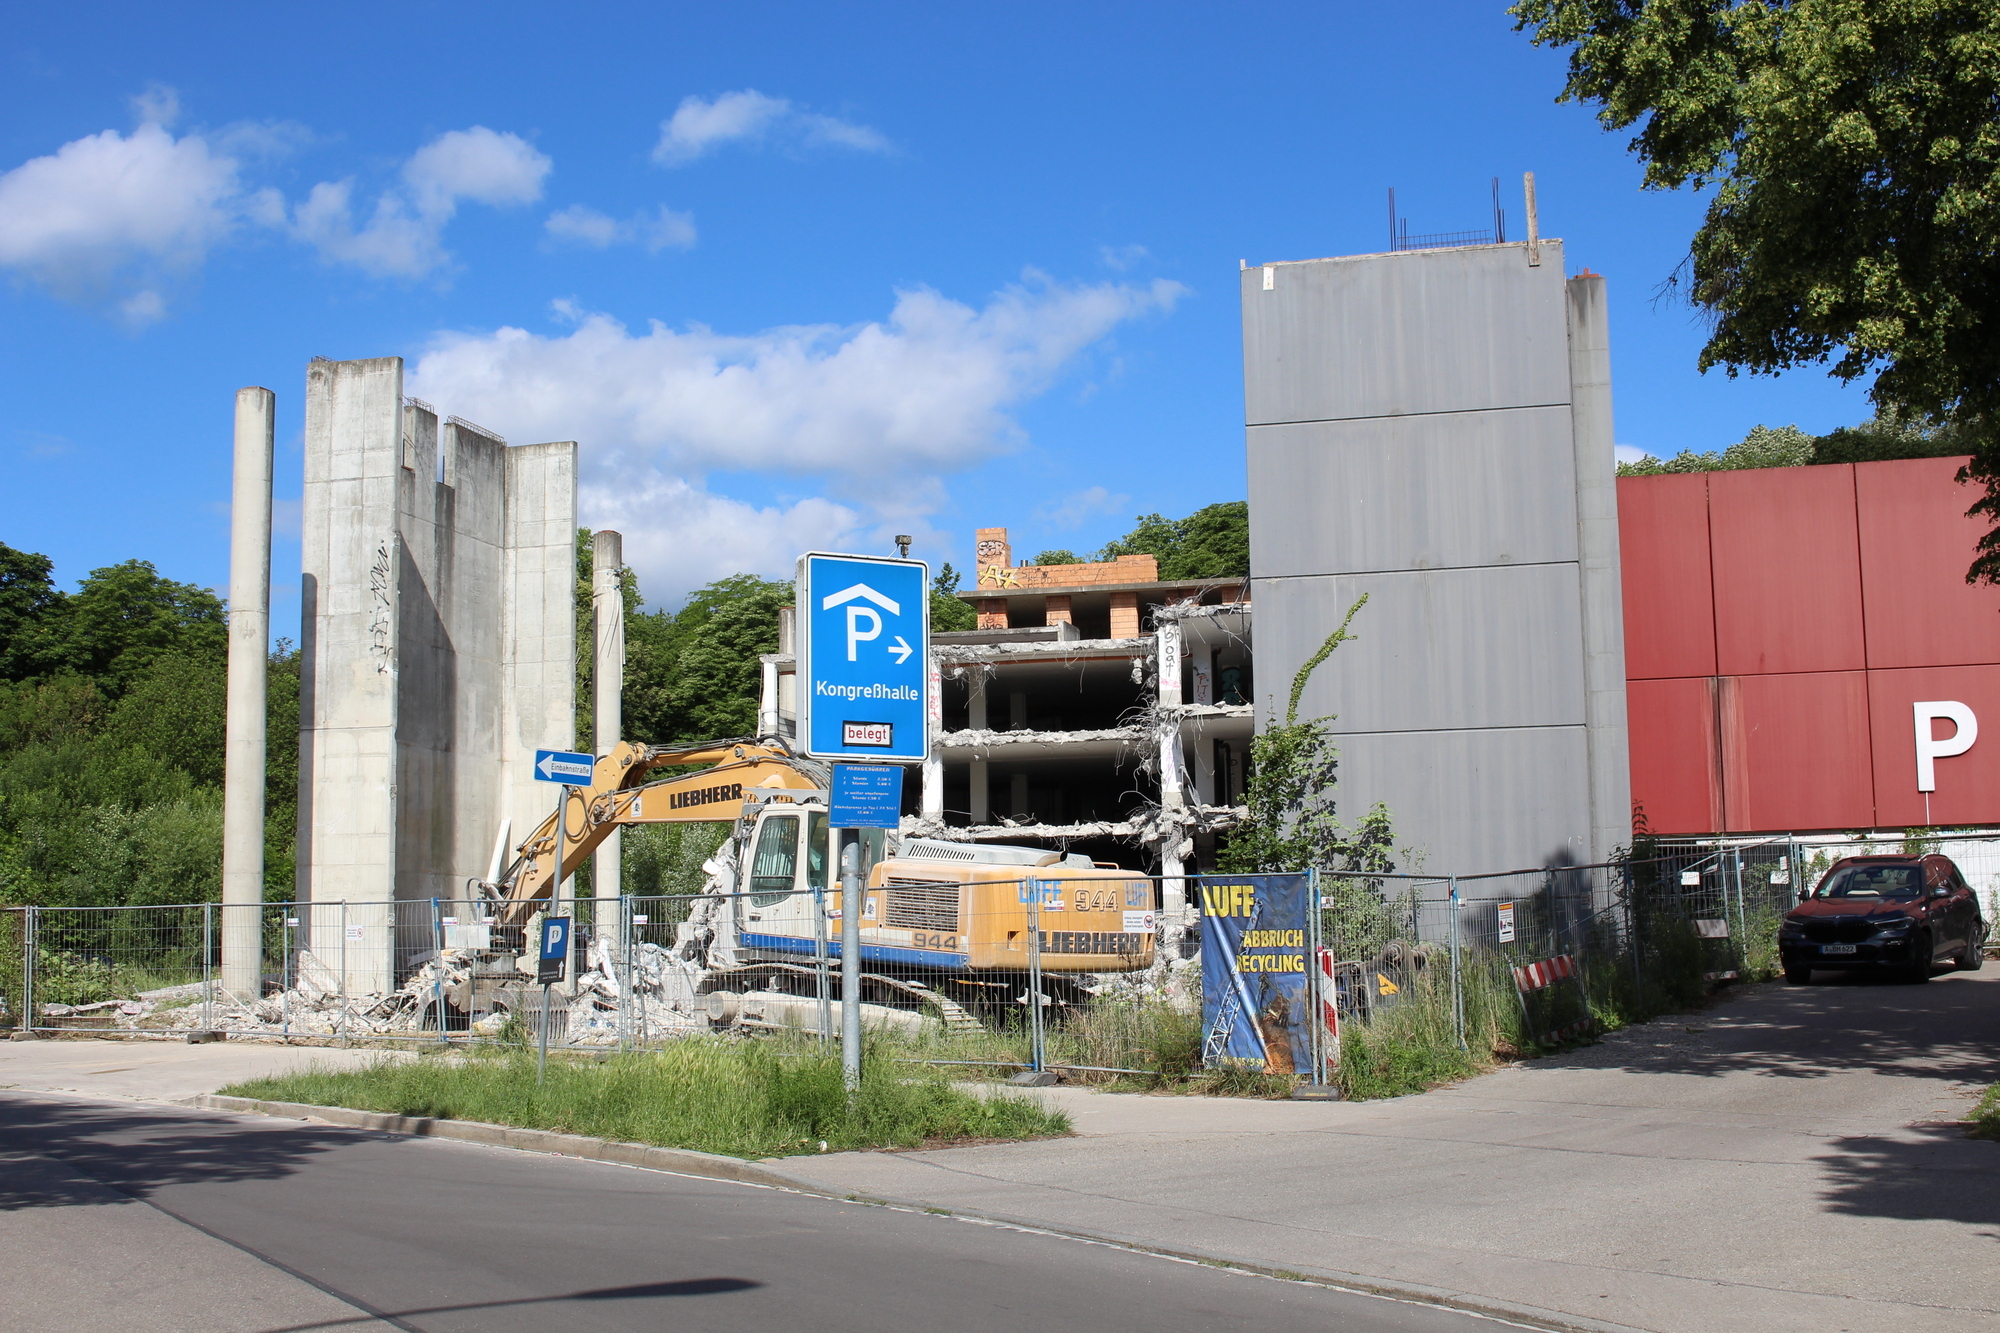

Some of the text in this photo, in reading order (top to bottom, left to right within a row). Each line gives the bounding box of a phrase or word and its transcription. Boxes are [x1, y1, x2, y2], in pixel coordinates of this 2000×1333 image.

[847, 606, 882, 661] P
[816, 680, 918, 701] Kongreßhalle
[848, 727, 887, 742] belegt
[1913, 701, 1978, 792] P
[550, 762, 590, 775] Einbahnstraße
[670, 783, 743, 809] LIEBHERR
[1074, 888, 1118, 912] 944
[1202, 885, 1255, 918] LUFF
[547, 925, 563, 953] P
[913, 931, 958, 950] 944
[1036, 931, 1141, 955] LIEBHERR
[1243, 929, 1304, 948] ABBRUCH
[1236, 955, 1305, 973] RECYCLING
